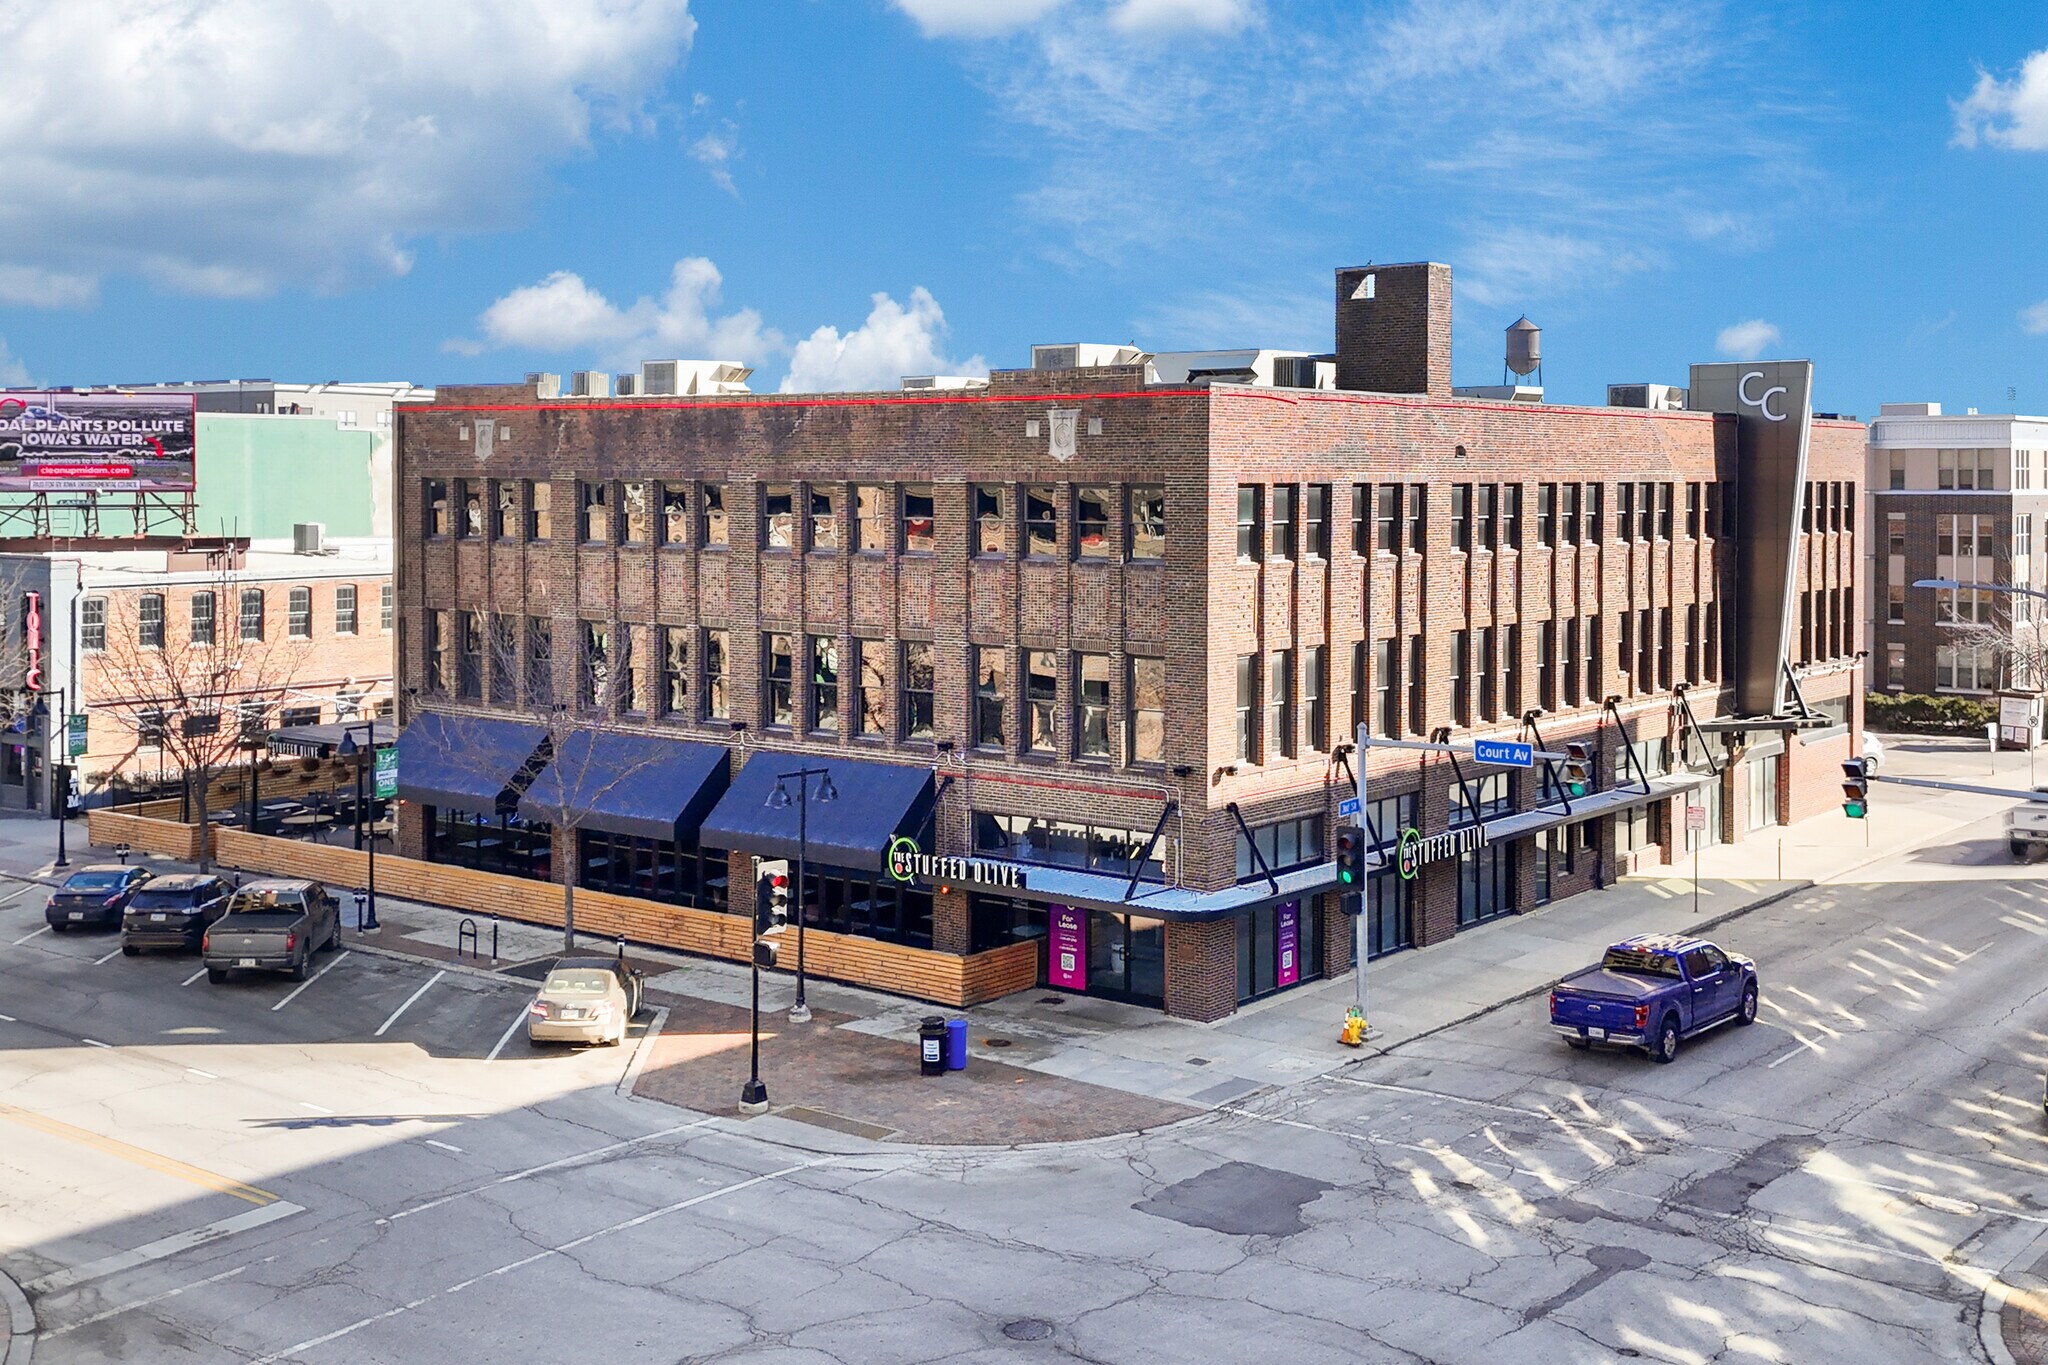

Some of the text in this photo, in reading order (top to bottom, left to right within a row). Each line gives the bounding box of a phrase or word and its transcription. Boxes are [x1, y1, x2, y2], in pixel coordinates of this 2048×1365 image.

[35, 419, 103, 432] PLANTS
[107, 420, 184, 432] POLLUTE
[22, 432, 148, 446] IOWA'S WATER.
[25, 457, 39, 465] Tell
[92, 457, 109, 465] take
[110, 457, 133, 465] action
[40, 466, 130, 475] cleanupmidam.com
[272, 741, 298, 756] STUFFED
[299, 745, 319, 759] OLIVE
[1477, 745, 1529, 762] Court Av
[378, 778, 396, 787] ONE
[1411, 833, 1456, 868] STUFFED
[1460, 825, 1490, 853] OLIVE
[893, 851, 1019, 888] THE STUFFED OLIVE
[1061, 914, 1074, 923] For
[1058, 920, 1078, 931] Lease
